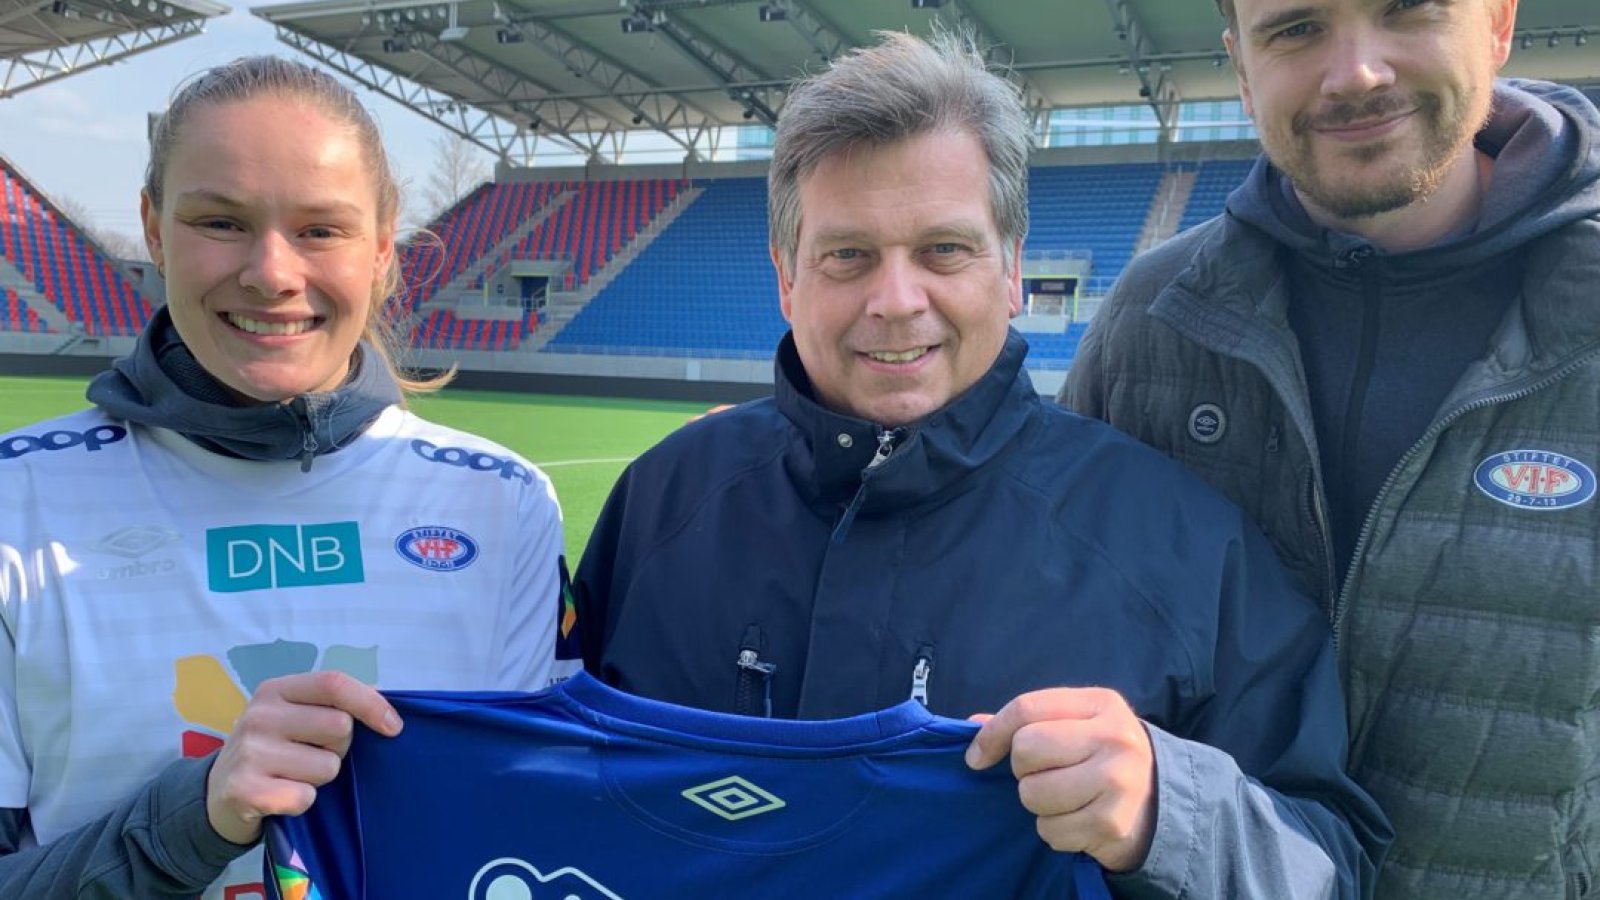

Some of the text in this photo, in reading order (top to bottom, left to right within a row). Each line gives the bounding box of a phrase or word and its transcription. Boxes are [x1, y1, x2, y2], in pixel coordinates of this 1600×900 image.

[0, 425, 127, 459] oop
[411, 438, 532, 485] coop
[228, 524, 345, 588] DNB
